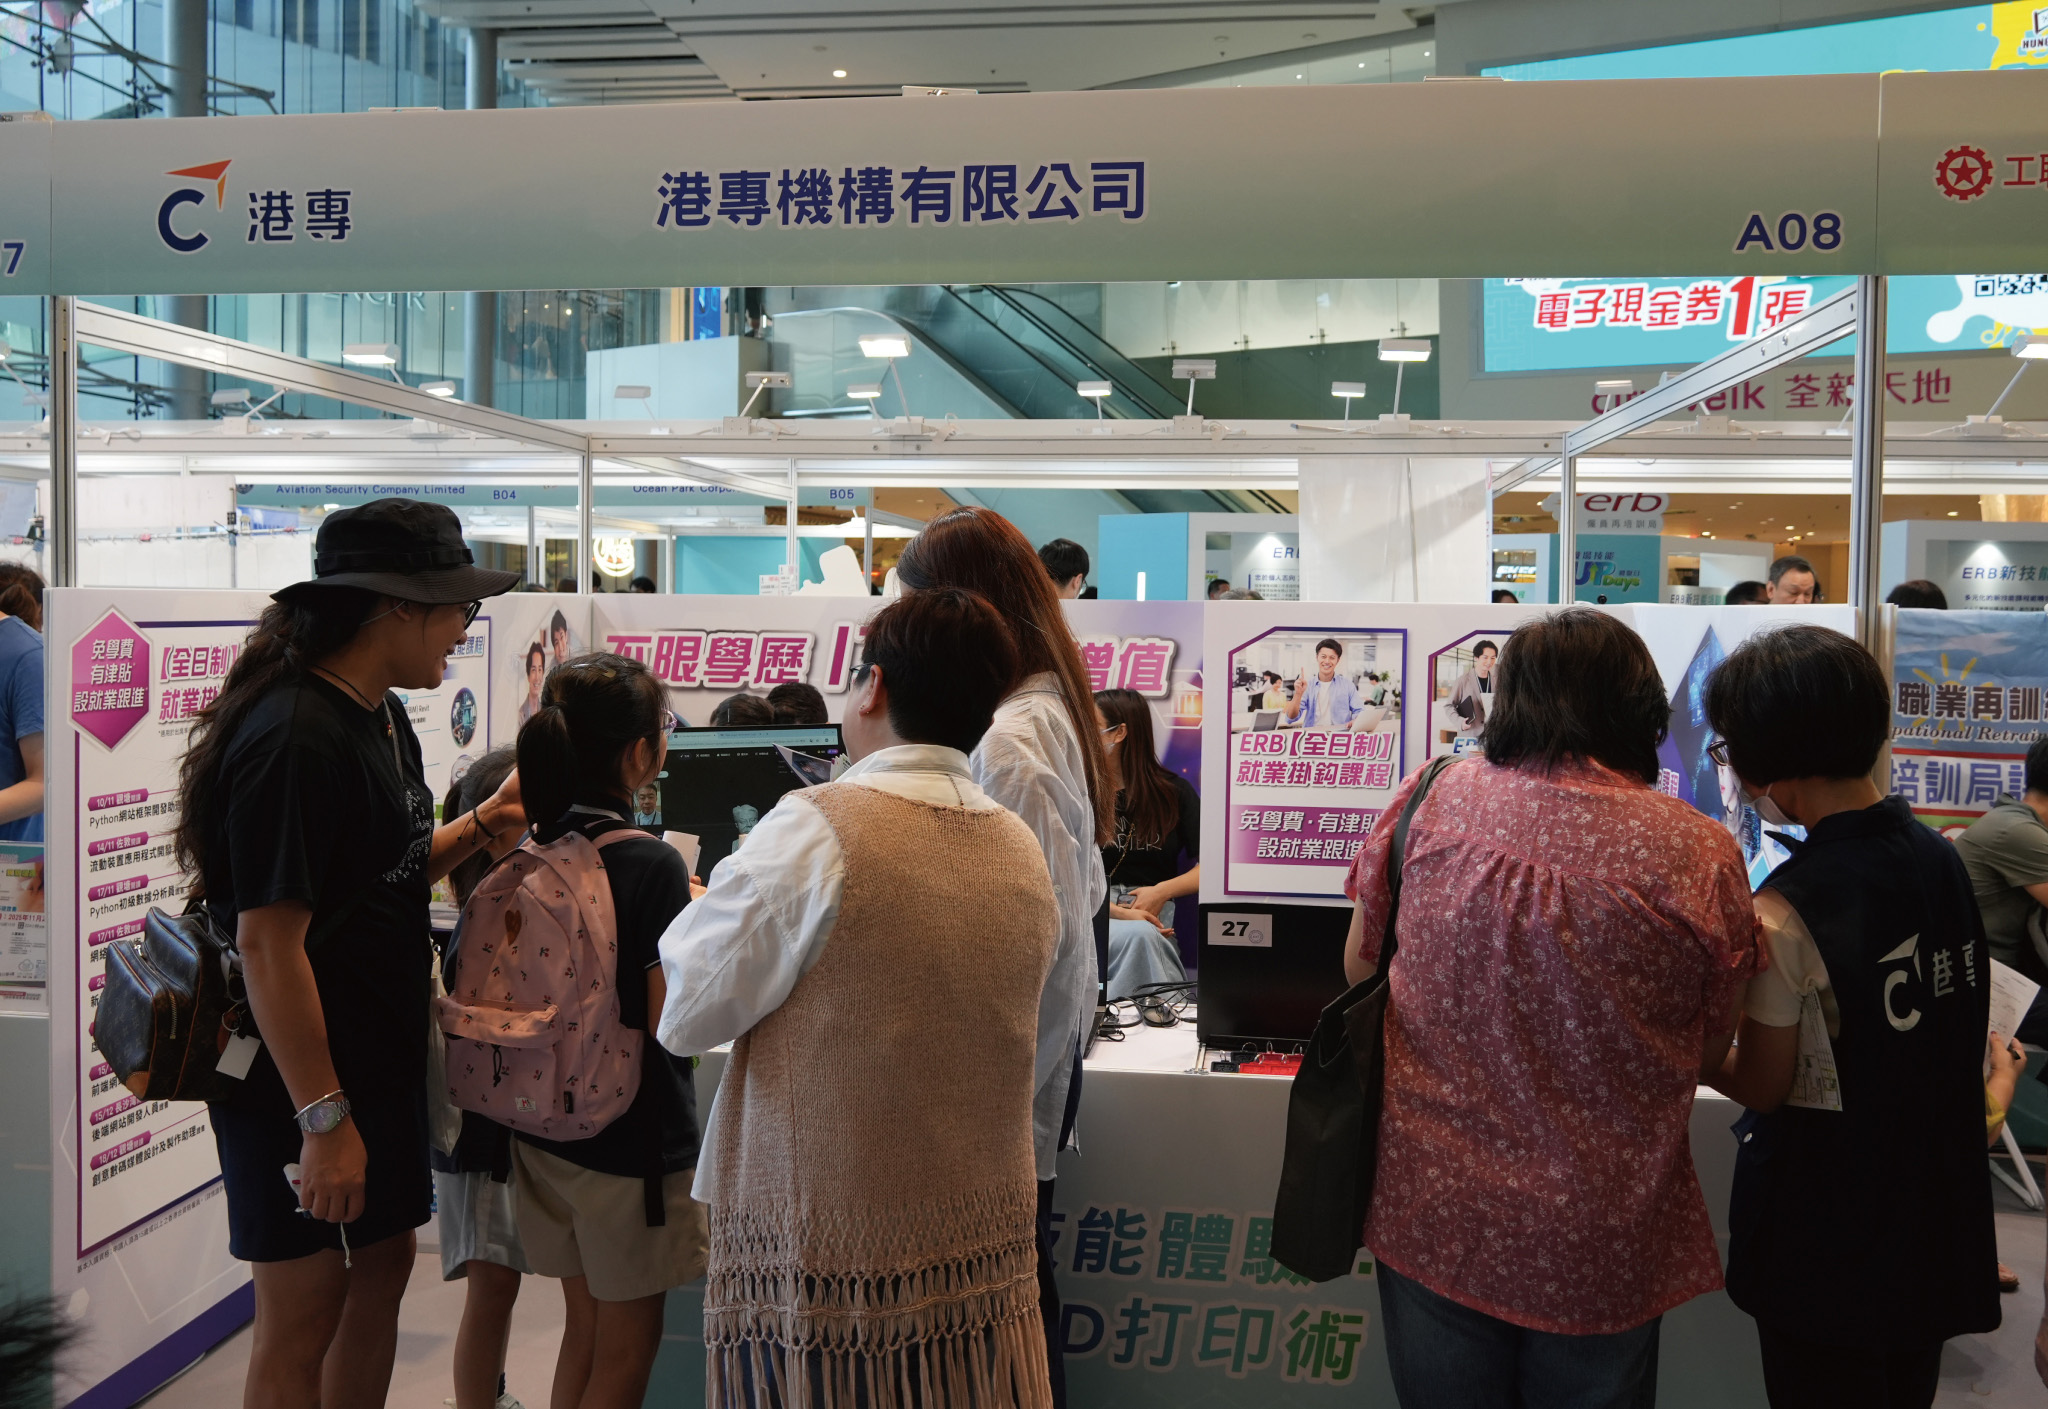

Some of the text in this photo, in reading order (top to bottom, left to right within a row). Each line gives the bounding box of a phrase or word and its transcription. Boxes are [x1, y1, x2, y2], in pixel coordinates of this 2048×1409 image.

[656, 161, 1146, 228] 港專機構有限公司
[247, 189, 351, 241] 港專
[1737, 212, 1841, 251] A08
[276, 485, 465, 496] Aviation Security Company Limited
[493, 490, 516, 500] B04
[830, 489, 854, 499] B05
[1584, 493, 1662, 512] erb
[1273, 547, 1299, 558] ER
[91, 639, 134, 660] 免學費
[73, 687, 145, 712] 設就業跟進
[1892, 682, 2048, 721] 職業再訓
[97, 797, 115, 807] 10/11
[97, 841, 115, 852] 14/11
[90, 843, 175, 872] 流動裝置應用程式開發
[97, 886, 115, 897] 17/11
[1221, 920, 1250, 936] 27
[97, 931, 115, 942] 17/11
[94, 1107, 113, 1121] 15/12
[99, 1148, 118, 1164] 18/12
